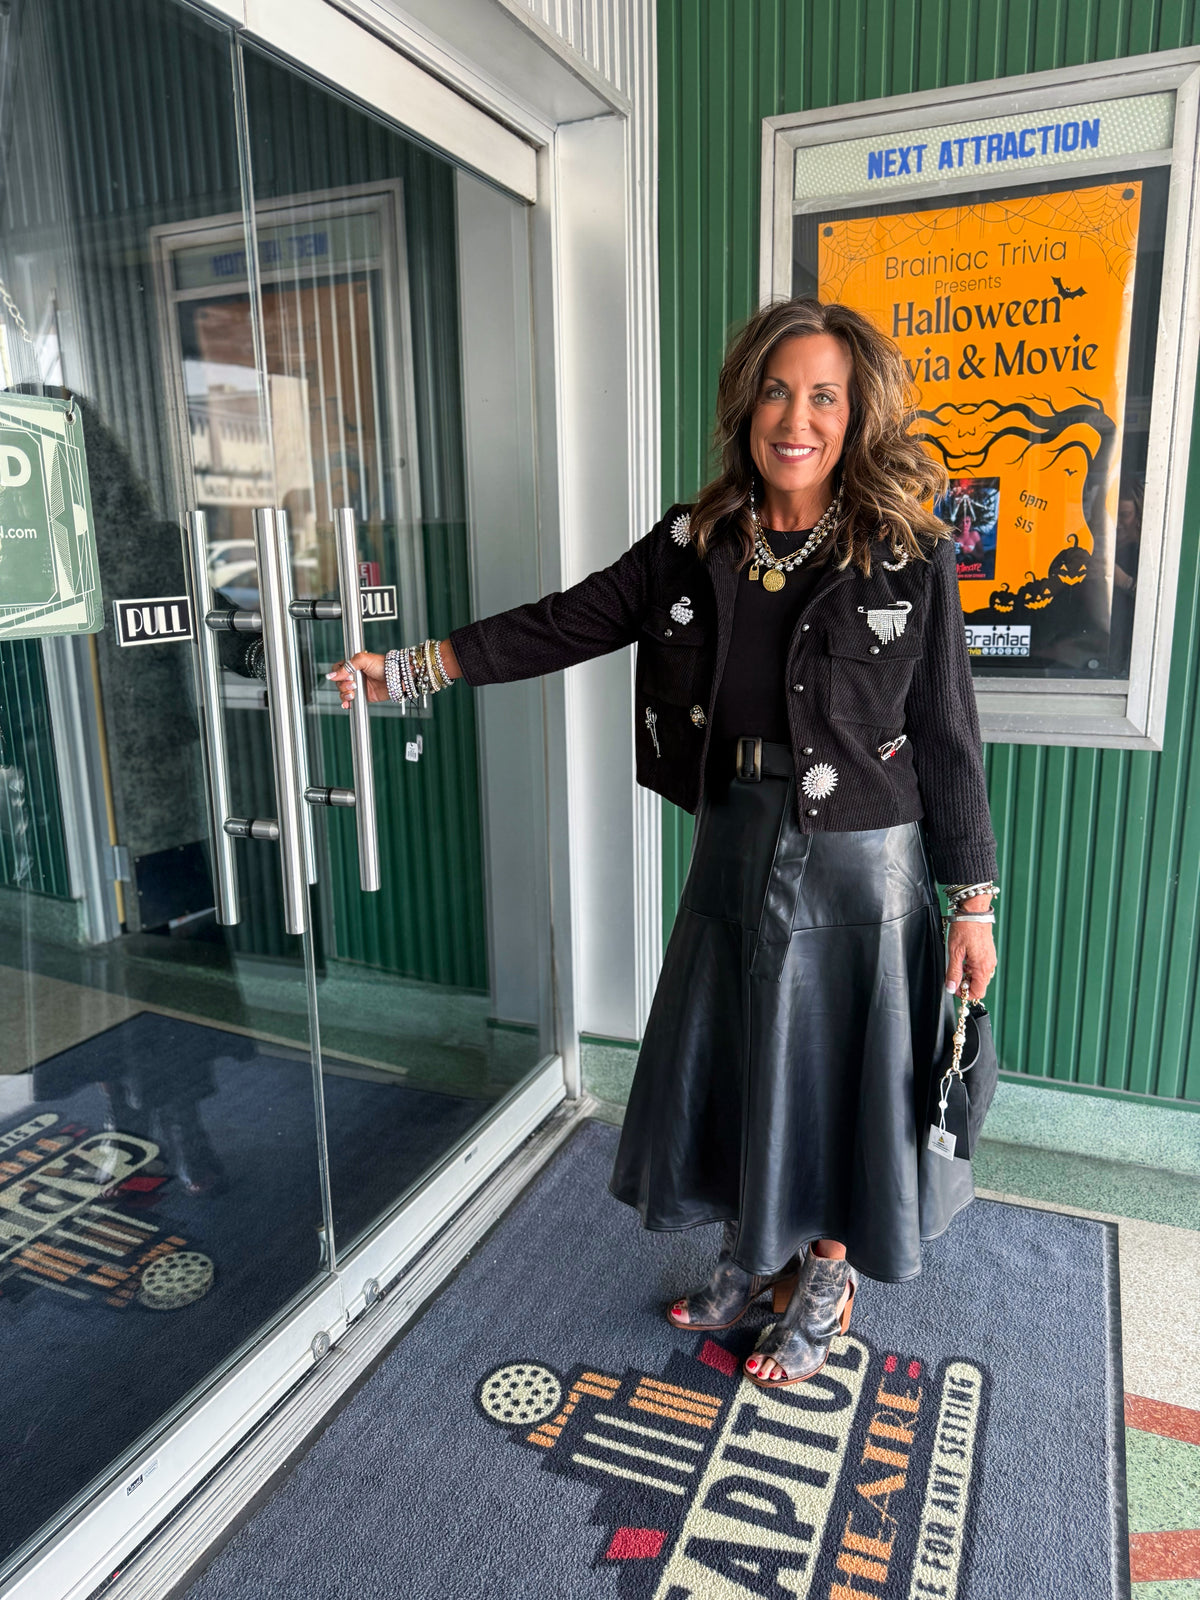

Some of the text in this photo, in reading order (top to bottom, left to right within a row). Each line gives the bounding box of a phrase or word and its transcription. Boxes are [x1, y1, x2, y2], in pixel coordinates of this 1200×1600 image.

[867, 118, 1101, 180] NEXT ATTRACTION
[884, 238, 1067, 280] Brainiac Trivia
[933, 275, 1002, 294] Presents
[891, 293, 1062, 338] Halloween
[901, 333, 1099, 383] via & Movie
[1019, 489, 1048, 511] 6pm
[1014, 515, 1035, 533] $15
[126, 604, 187, 637] PULL
[965, 624, 1029, 646] Brainiac
[937, 1375, 975, 1460] SETTING
[666, 1344, 864, 1600] APITO
[930, 1463, 965, 1514] ANY
[920, 1520, 957, 1572] FOR
